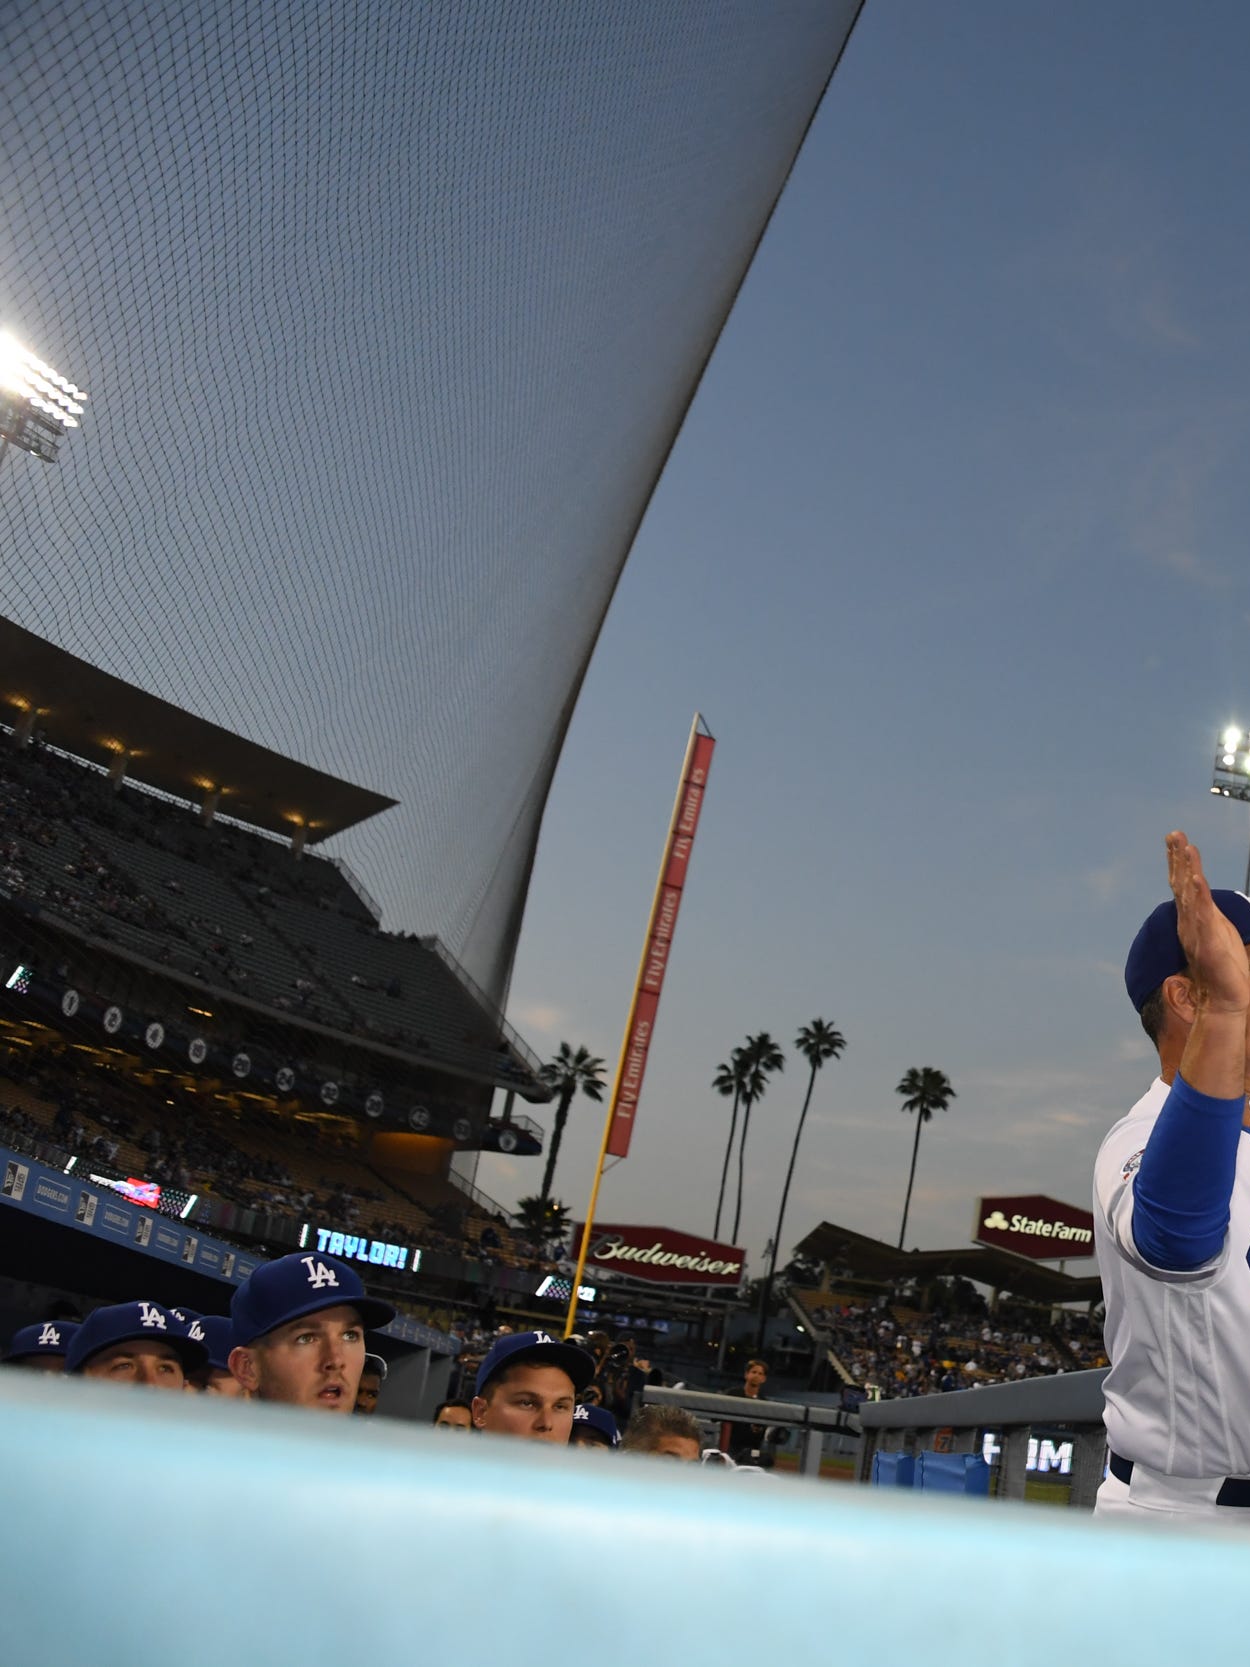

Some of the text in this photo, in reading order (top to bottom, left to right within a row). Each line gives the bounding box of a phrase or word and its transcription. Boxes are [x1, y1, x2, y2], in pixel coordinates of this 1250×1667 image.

[679, 768, 703, 832] Emiraes
[645, 892, 677, 986] Fly Emirates
[617, 1021, 649, 1118] Fly Emirates
[316, 1228, 408, 1269] TAYLOR!
[589, 1234, 741, 1275] Budweiser
[301, 1256, 339, 1289] LA
[38, 1323, 61, 1346] LA
[138, 1302, 167, 1330] LA
[573, 1404, 589, 1420] LA
